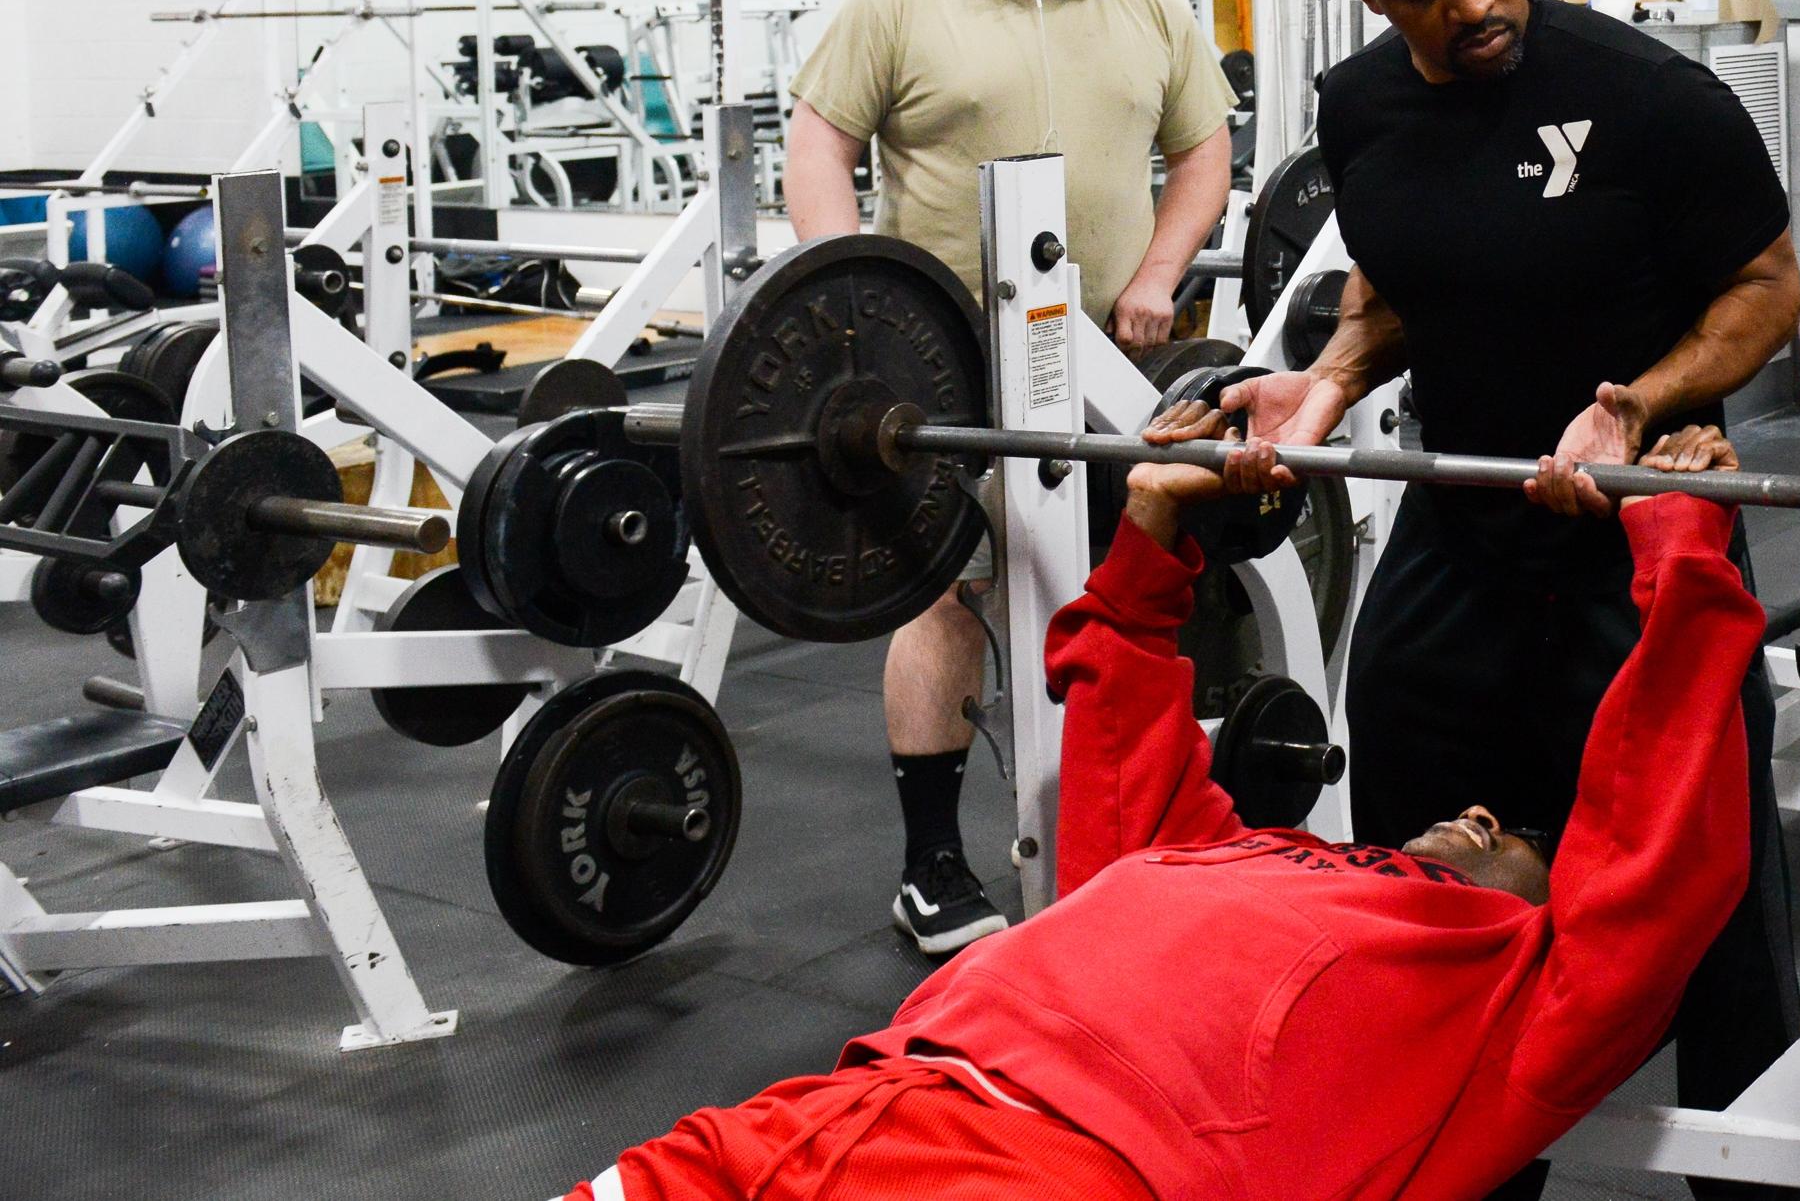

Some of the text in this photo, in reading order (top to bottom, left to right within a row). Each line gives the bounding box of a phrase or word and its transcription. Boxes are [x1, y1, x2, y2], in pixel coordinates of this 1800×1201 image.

[1297, 175, 1334, 207] 45L
[1517, 161, 1543, 178] the
[1567, 173, 1580, 193] YMCA
[736, 293, 840, 419] YORK
[737, 460, 847, 584] BARBELL
[674, 742, 710, 809] USA
[561, 786, 610, 913] YORK
